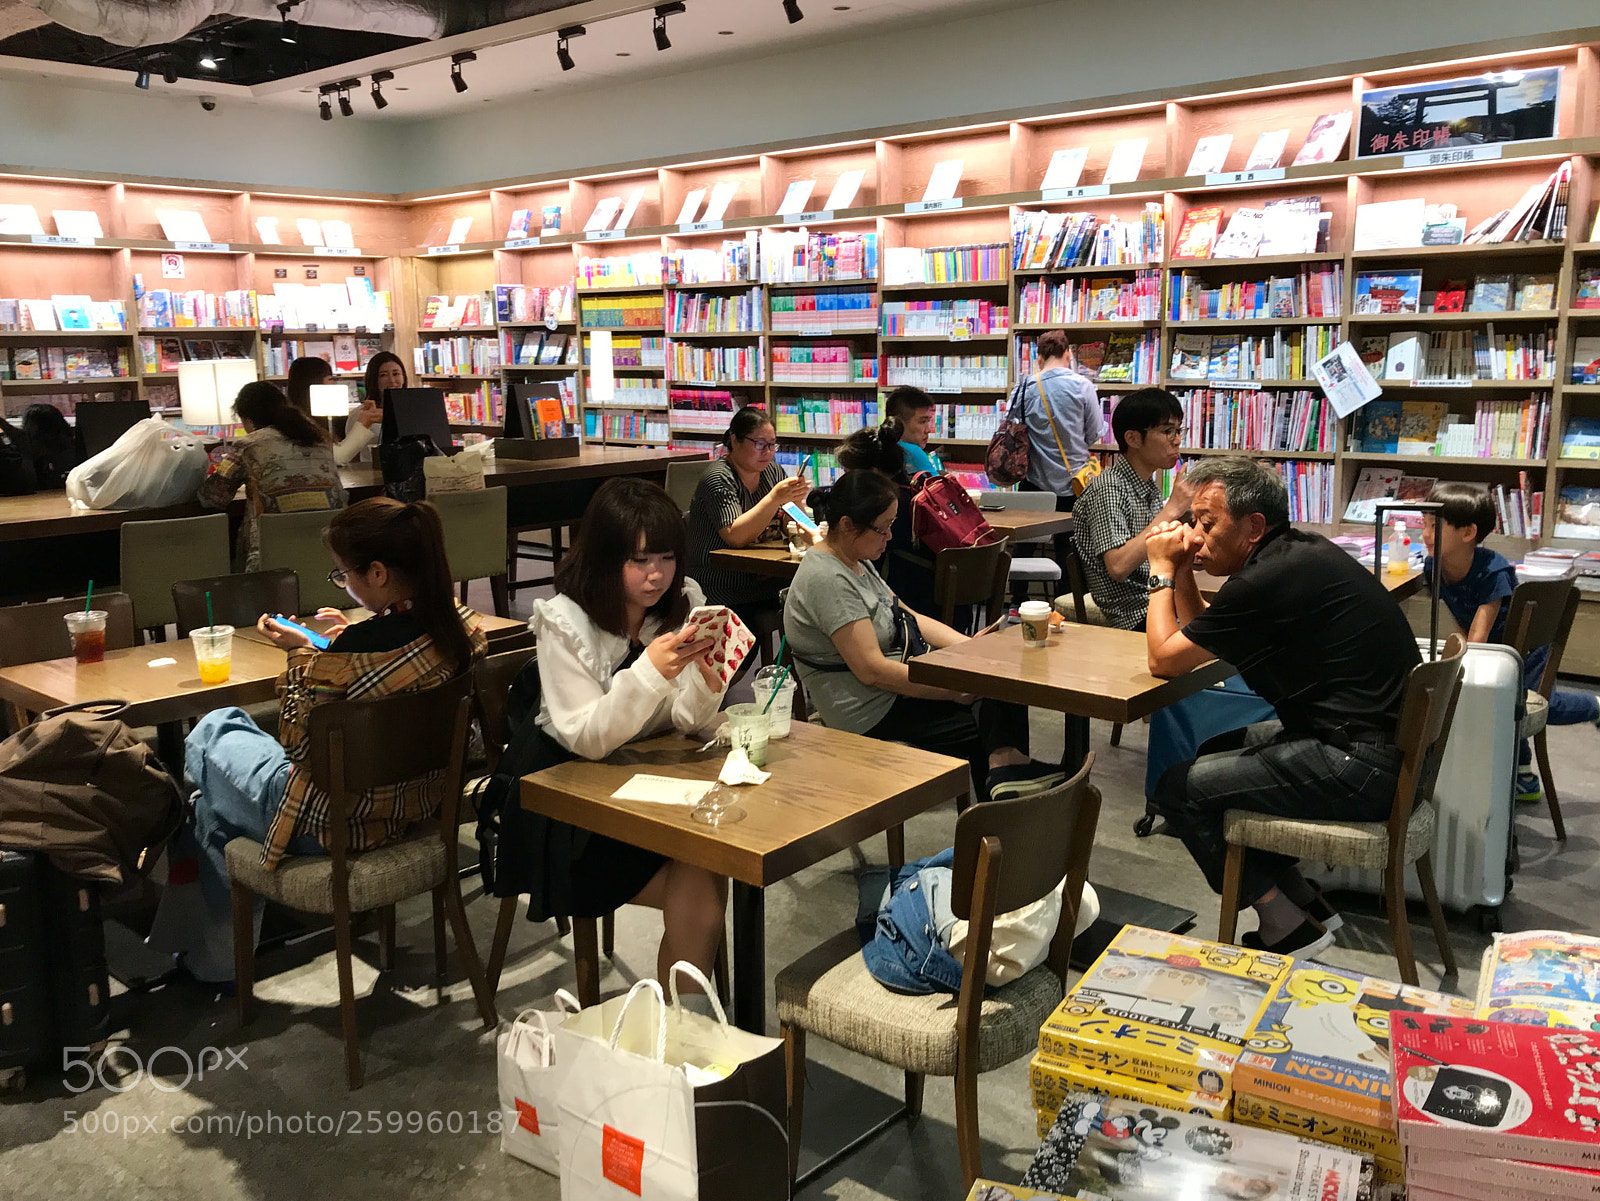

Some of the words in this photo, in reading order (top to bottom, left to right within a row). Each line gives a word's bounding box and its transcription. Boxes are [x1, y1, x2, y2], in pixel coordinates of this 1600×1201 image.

[1370, 126, 1452, 153] 御朱印帳
[1429, 149, 1475, 164] 御朱印帳
[1079, 1019, 1200, 1056] ミニオン
[1069, 1042, 1129, 1068] ミニオン
[1131, 1056, 1194, 1078] 収納トートバッグ
[1132, 1067, 1161, 1079] BOOK
[1253, 1077, 1291, 1094] MINION
[1267, 1105, 1338, 1136] ミニオン
[1343, 1136, 1375, 1150] BOOK
[1496, 1142, 1534, 1154] Mickey
